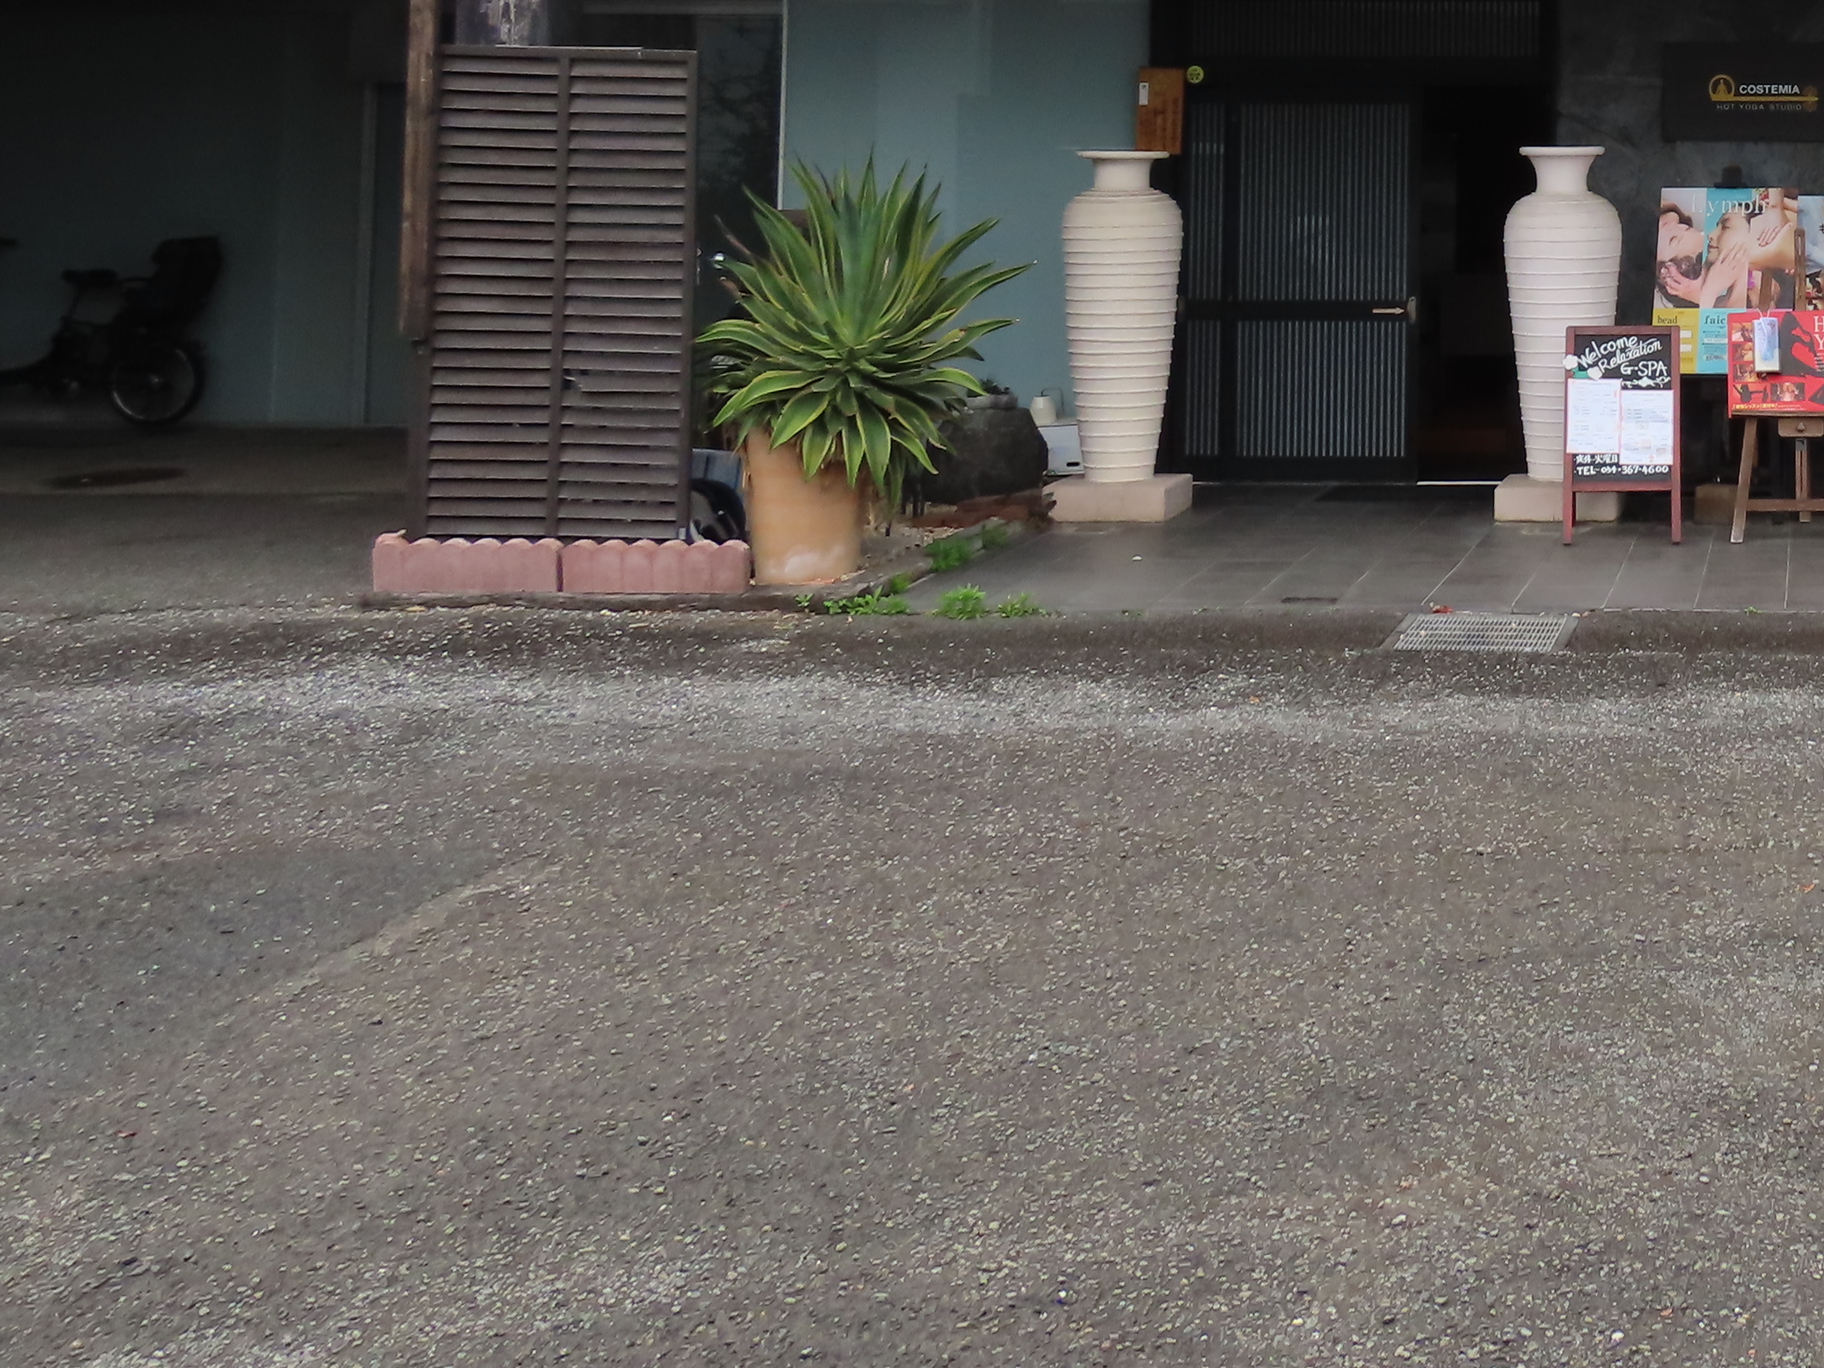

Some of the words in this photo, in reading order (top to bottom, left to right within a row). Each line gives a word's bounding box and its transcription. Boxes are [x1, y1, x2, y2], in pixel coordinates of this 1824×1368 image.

[1738, 84, 1801, 94] COSTEMIA
[1691, 194, 1767, 217] Lymph
[1657, 315, 1678, 325] head
[1577, 335, 1639, 369] Welcome
[1597, 338, 1663, 373] Relaxation
